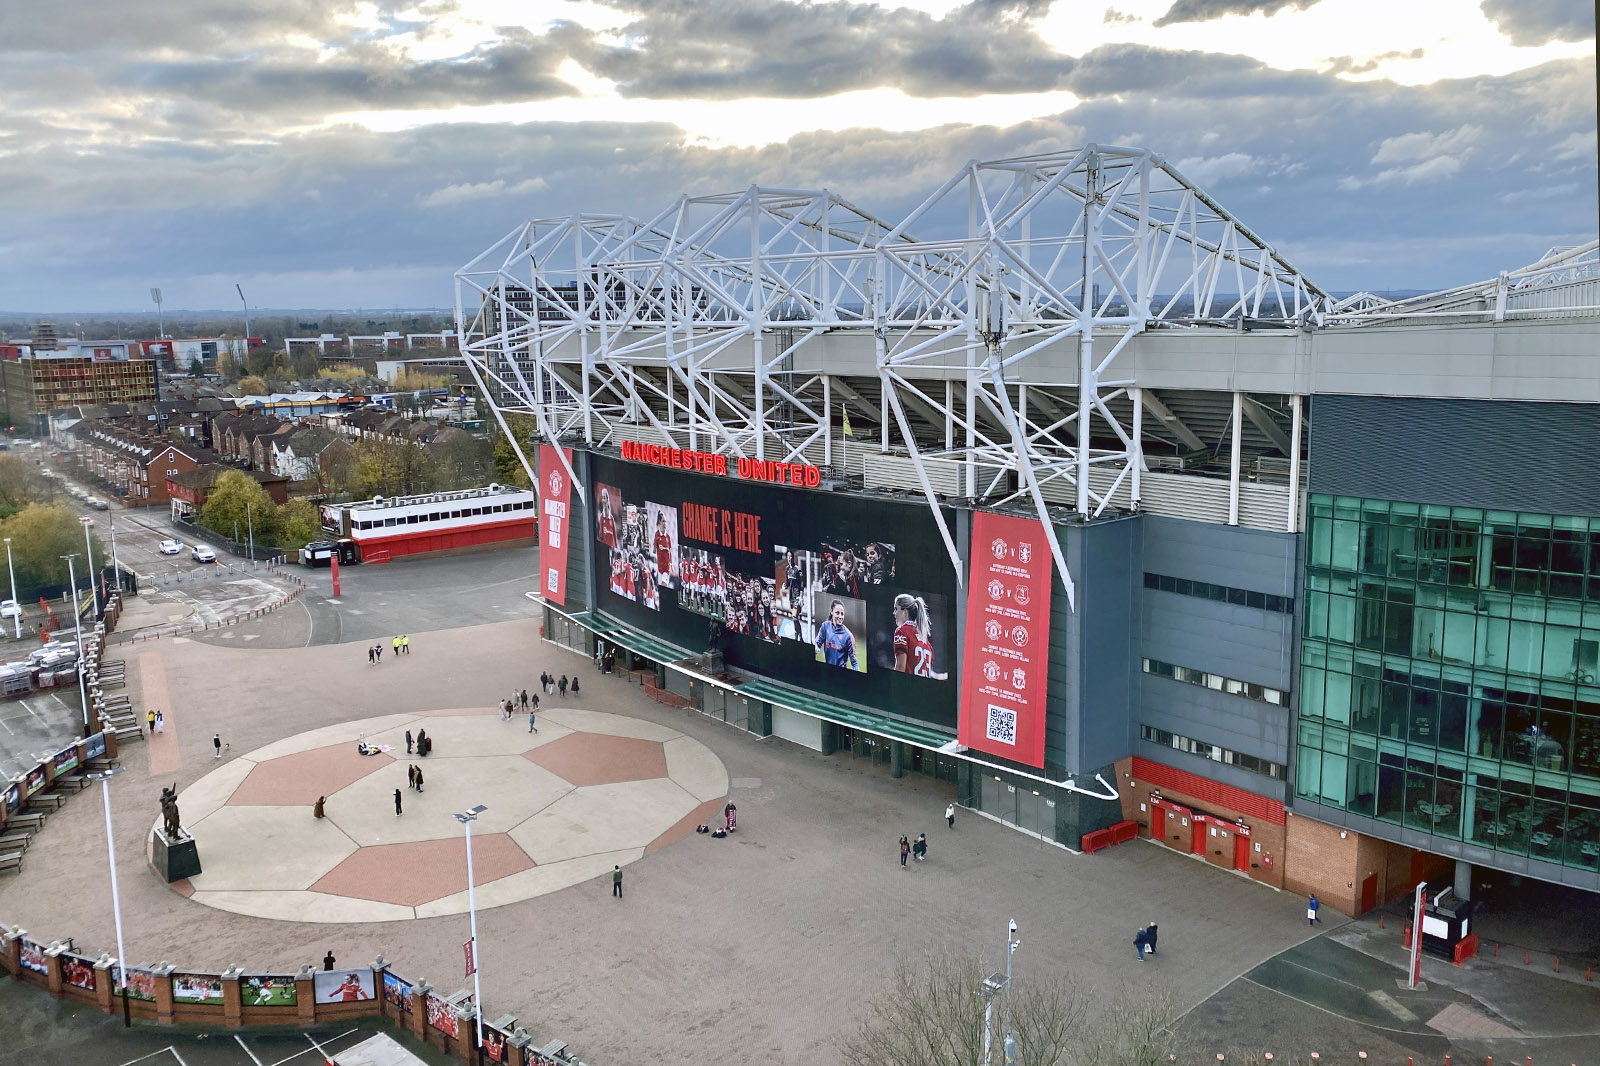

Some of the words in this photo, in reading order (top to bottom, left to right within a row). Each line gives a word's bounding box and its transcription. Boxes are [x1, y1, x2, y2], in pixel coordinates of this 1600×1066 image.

[621, 440, 727, 476] MANCHESTER
[738, 457, 821, 487] UNITED
[682, 502, 719, 545] CHANGE
[721, 509, 732, 548] IS
[734, 511, 762, 554] HERE
[914, 646, 932, 678] 23
